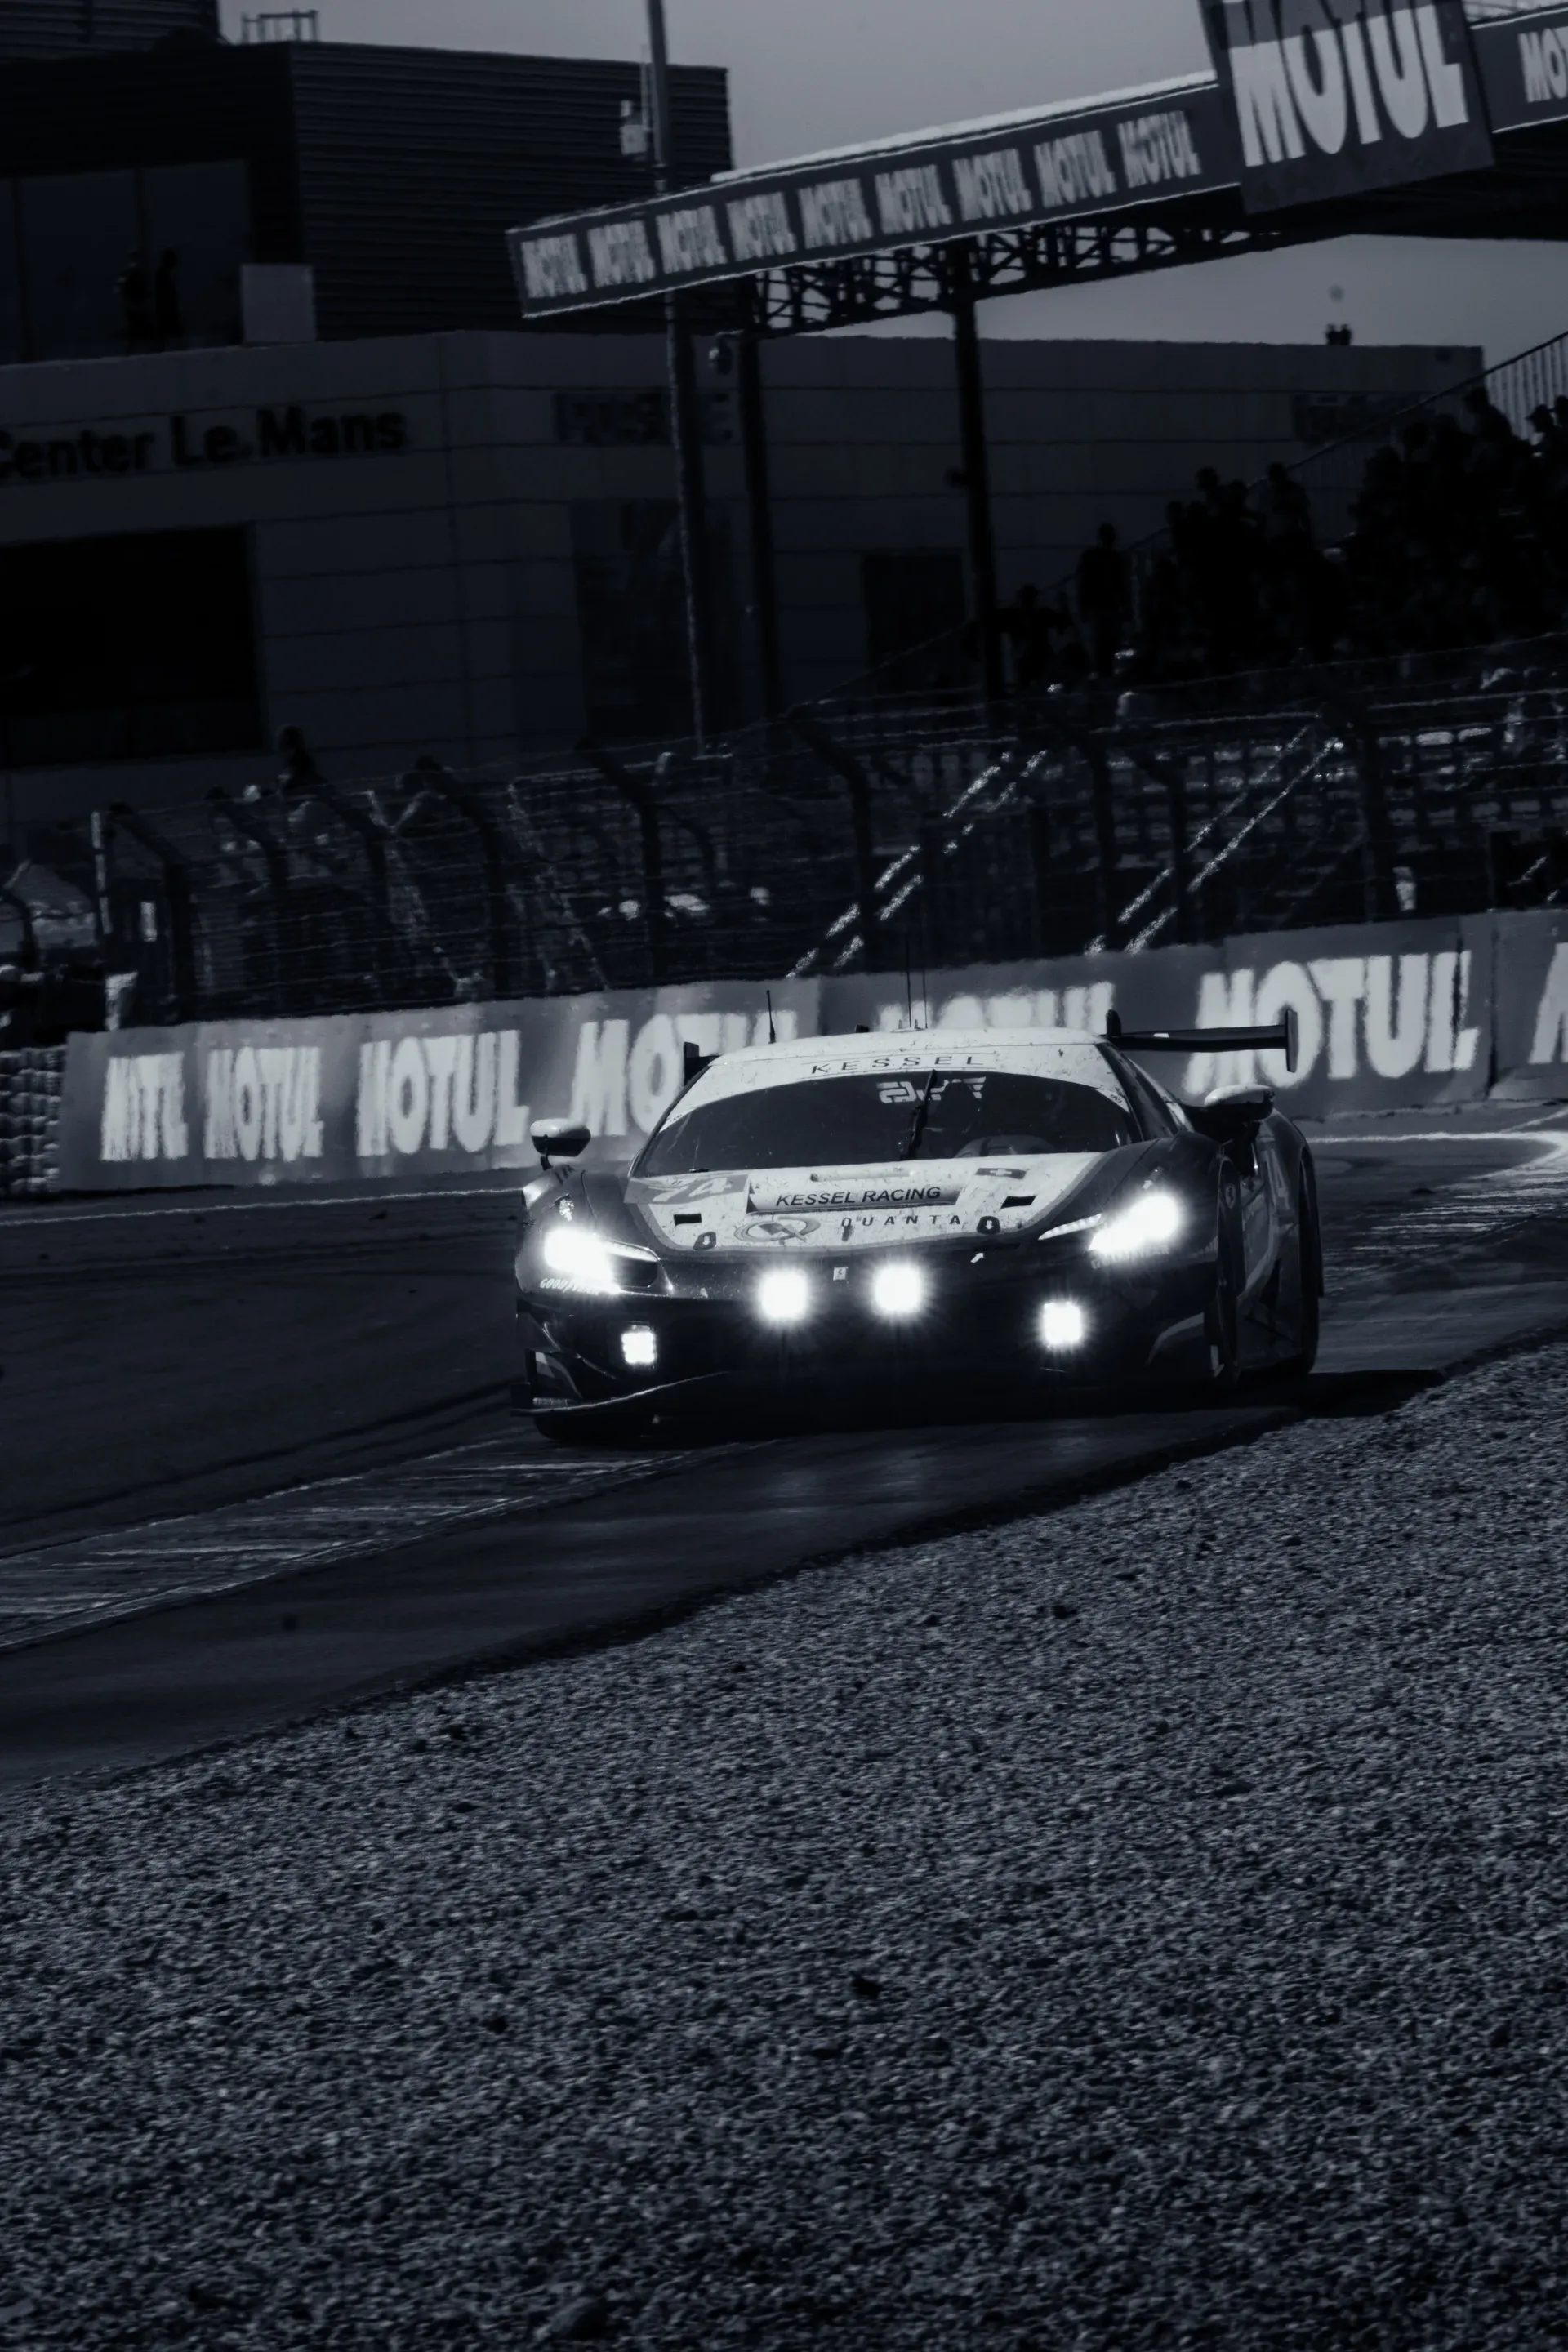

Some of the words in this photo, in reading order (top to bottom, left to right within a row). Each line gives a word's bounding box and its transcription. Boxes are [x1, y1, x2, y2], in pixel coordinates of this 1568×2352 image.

[1222, 0, 1469, 167] MOTUL
[1033, 129, 1117, 209] MOTUL
[1116, 109, 1202, 189] MOTUL
[171, 415, 238, 466] Le
[256, 405, 407, 457] Mans
[203, 1046, 324, 1162] MOTUL
[355, 1029, 530, 1156] MOTUL
[1182, 950, 1480, 1095] MOTUL
[811, 1056, 984, 1075] KESSEL
[775, 1190, 857, 1206] KESSEL
[862, 1187, 942, 1203] RACING
[840, 1214, 961, 1227] QUANTA
